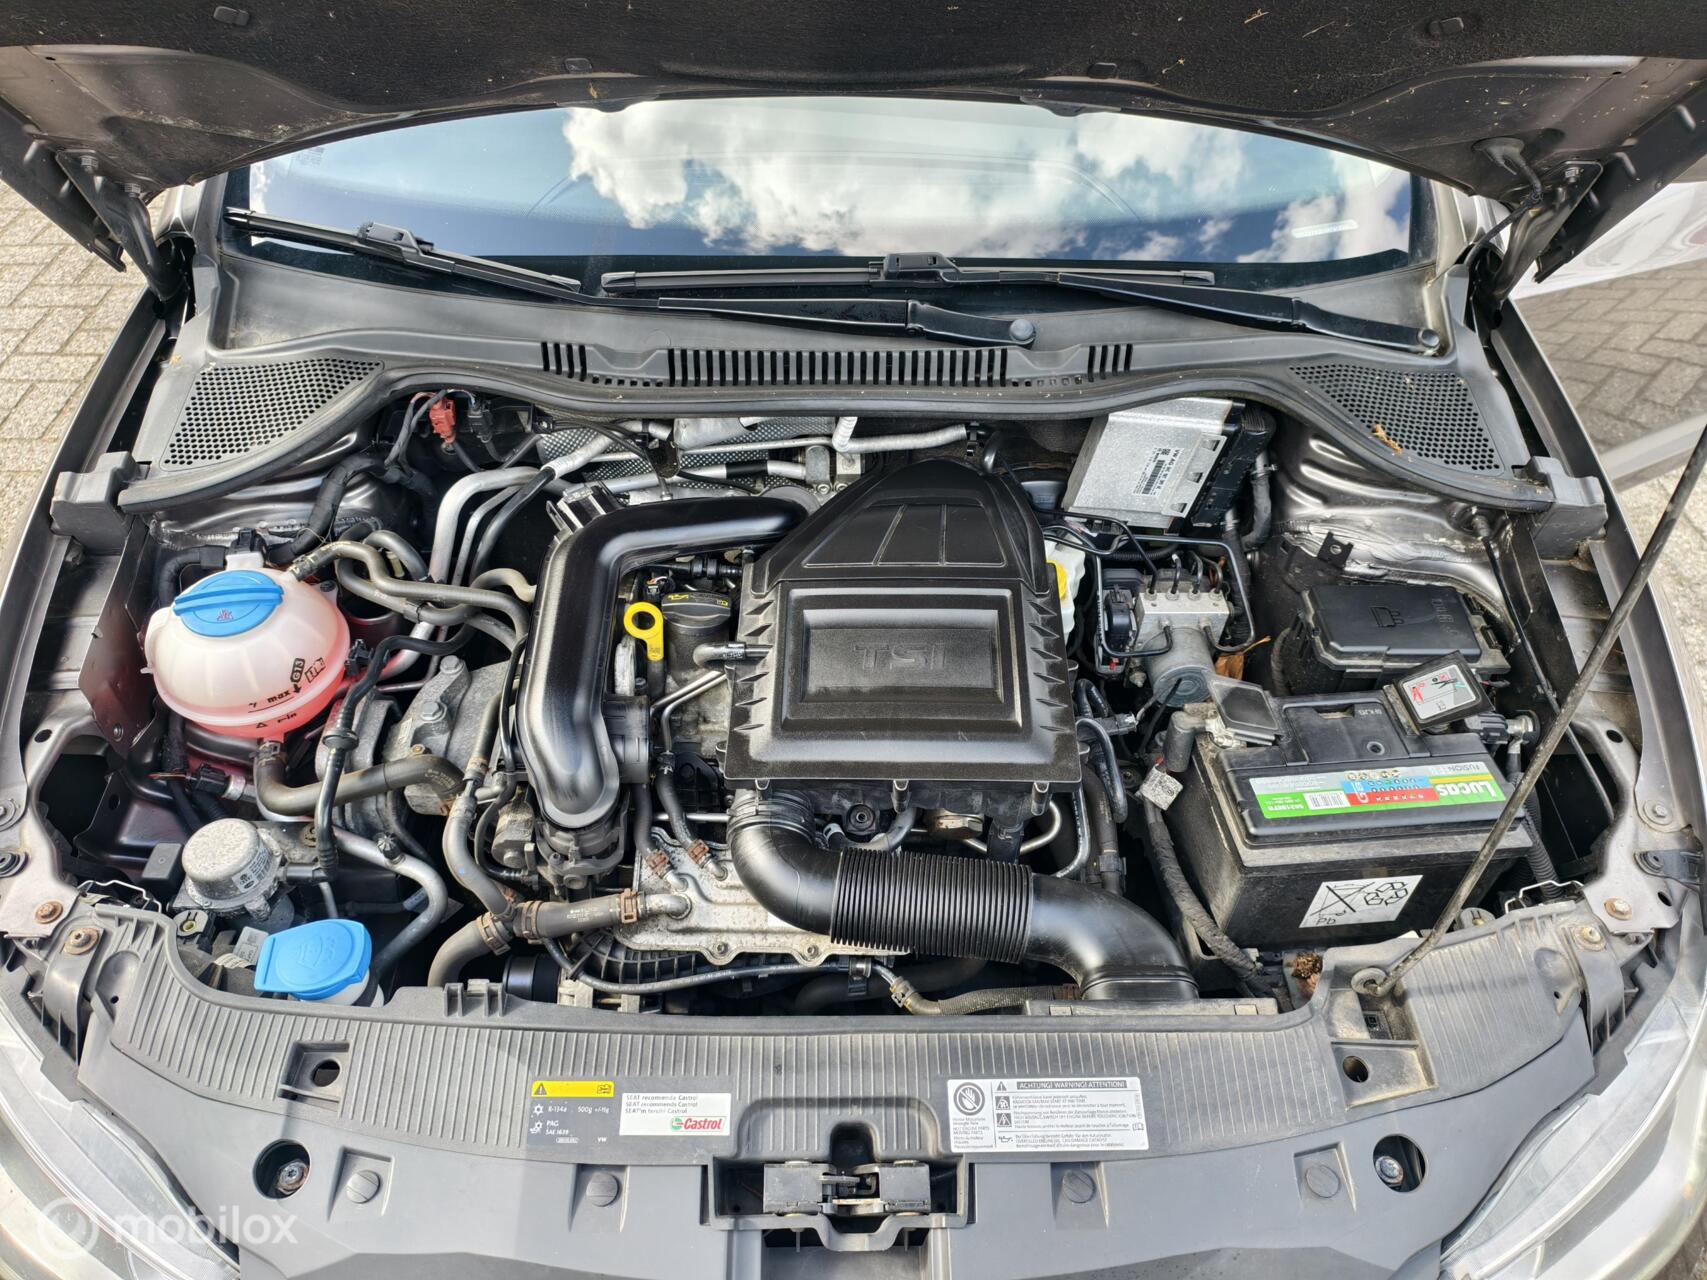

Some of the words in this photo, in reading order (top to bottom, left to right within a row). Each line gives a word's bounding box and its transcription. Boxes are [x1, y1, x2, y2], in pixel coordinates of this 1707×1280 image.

[852, 643, 947, 671] TSI
[267, 690, 291, 703] max
[1435, 780, 1497, 798] Lucas
[1316, 918, 1336, 926] Pb
[683, 1116, 723, 1131] Castrol
